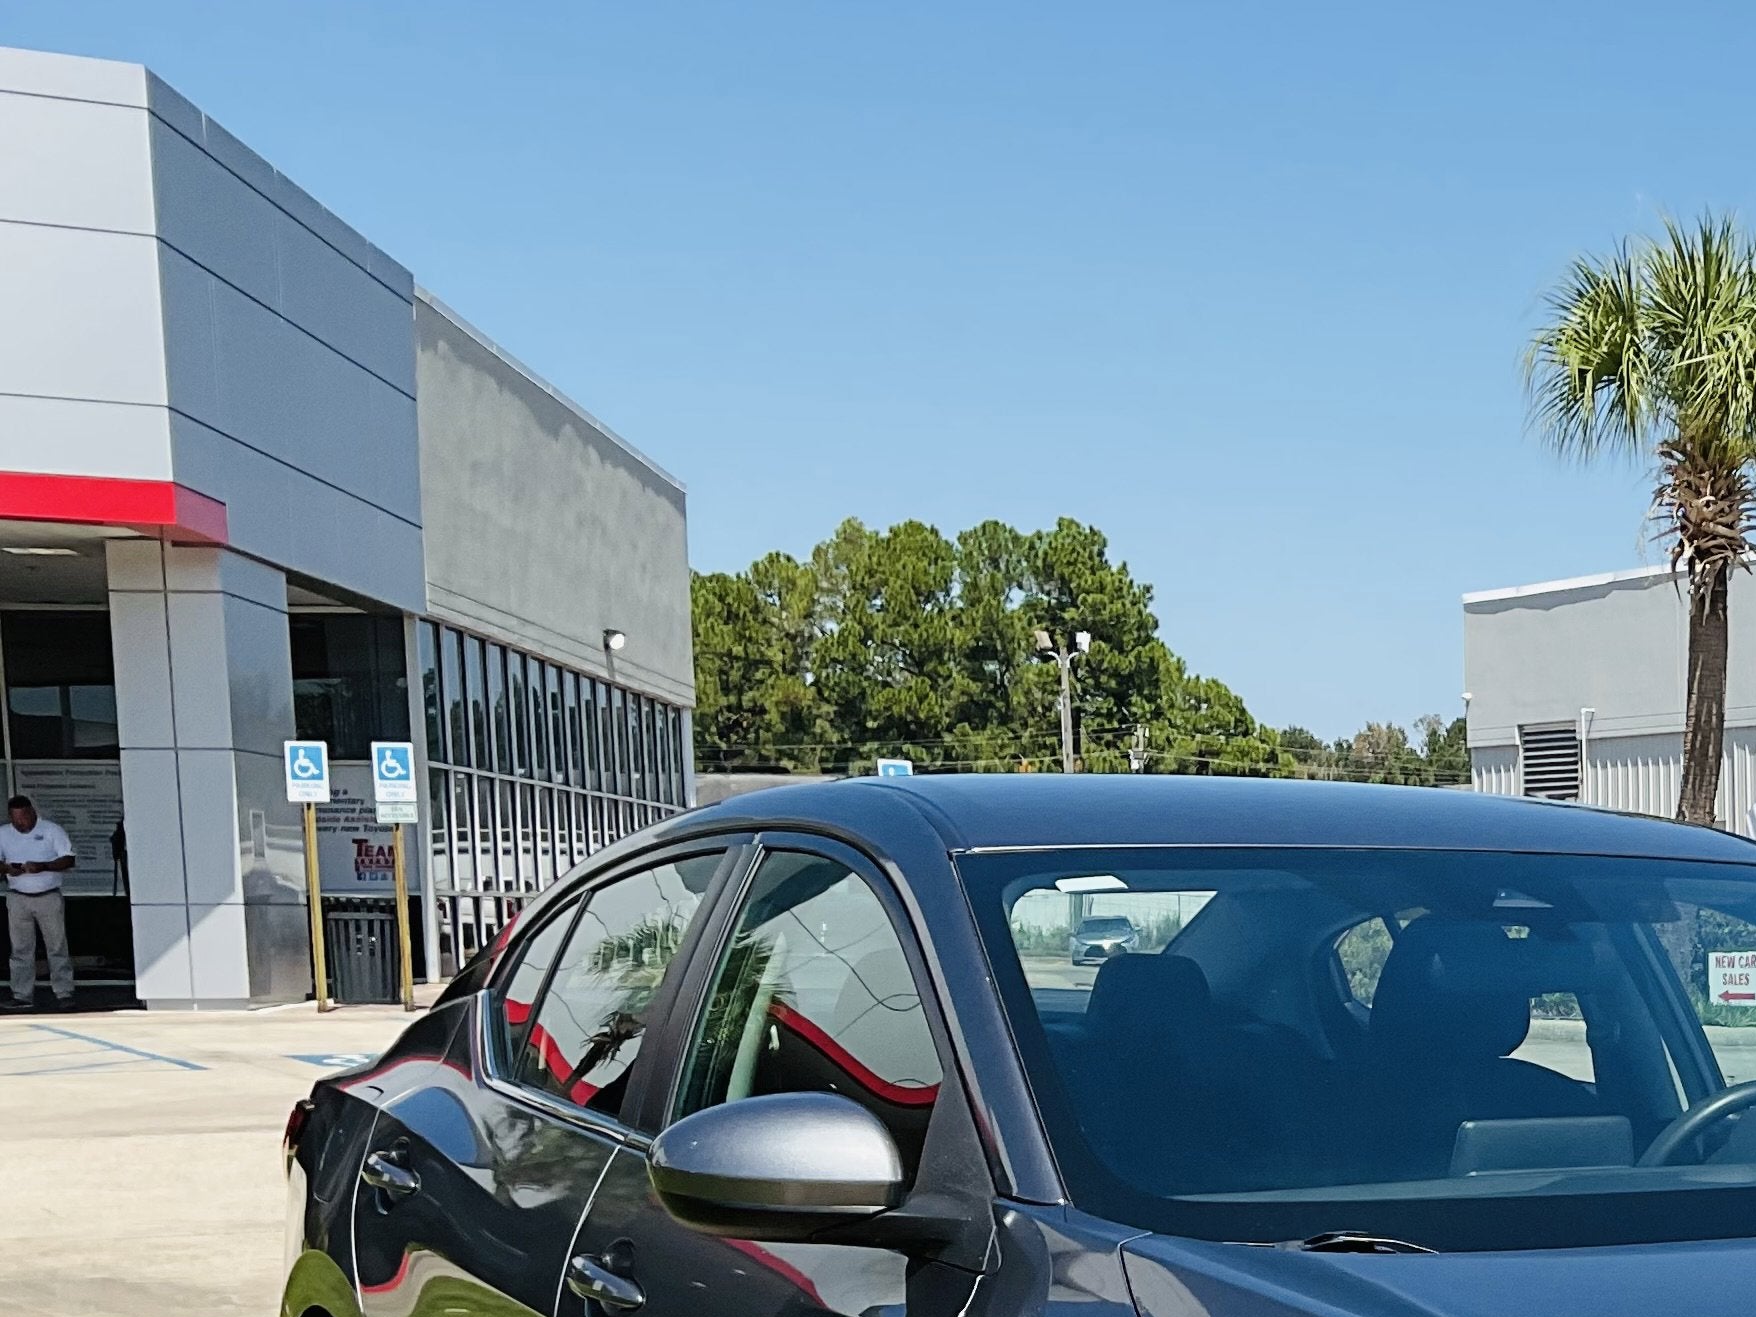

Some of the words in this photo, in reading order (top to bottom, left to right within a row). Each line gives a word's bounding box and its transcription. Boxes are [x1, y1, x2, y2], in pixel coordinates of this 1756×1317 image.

[1715, 956, 1735, 968] NEW
[1739, 955, 1756, 968] CAR
[1722, 973, 1750, 985] SALES
